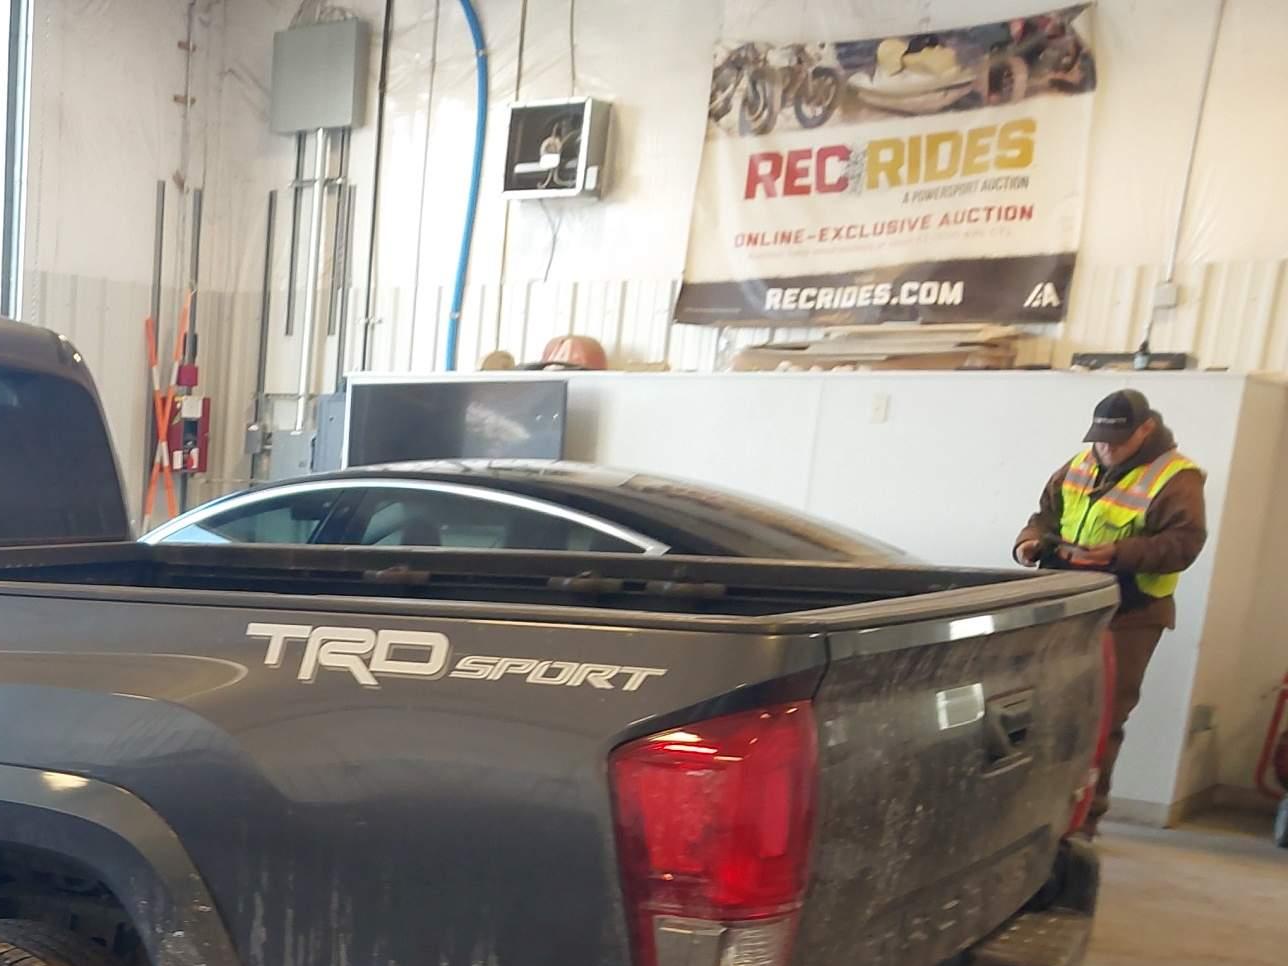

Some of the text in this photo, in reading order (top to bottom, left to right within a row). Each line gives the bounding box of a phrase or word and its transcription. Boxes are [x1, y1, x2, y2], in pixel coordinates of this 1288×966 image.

[744, 144, 852, 200] REC
[865, 118, 1038, 190] RIDES
[981, 176, 1030, 192] AUCTION
[734, 213, 930, 248] ONLINE-EXCLUSIVE
[938, 204, 1034, 228] AUCTION
[764, 281, 964, 311] RECRIDES.COM
[246, 622, 668, 692] TRD SPORT
